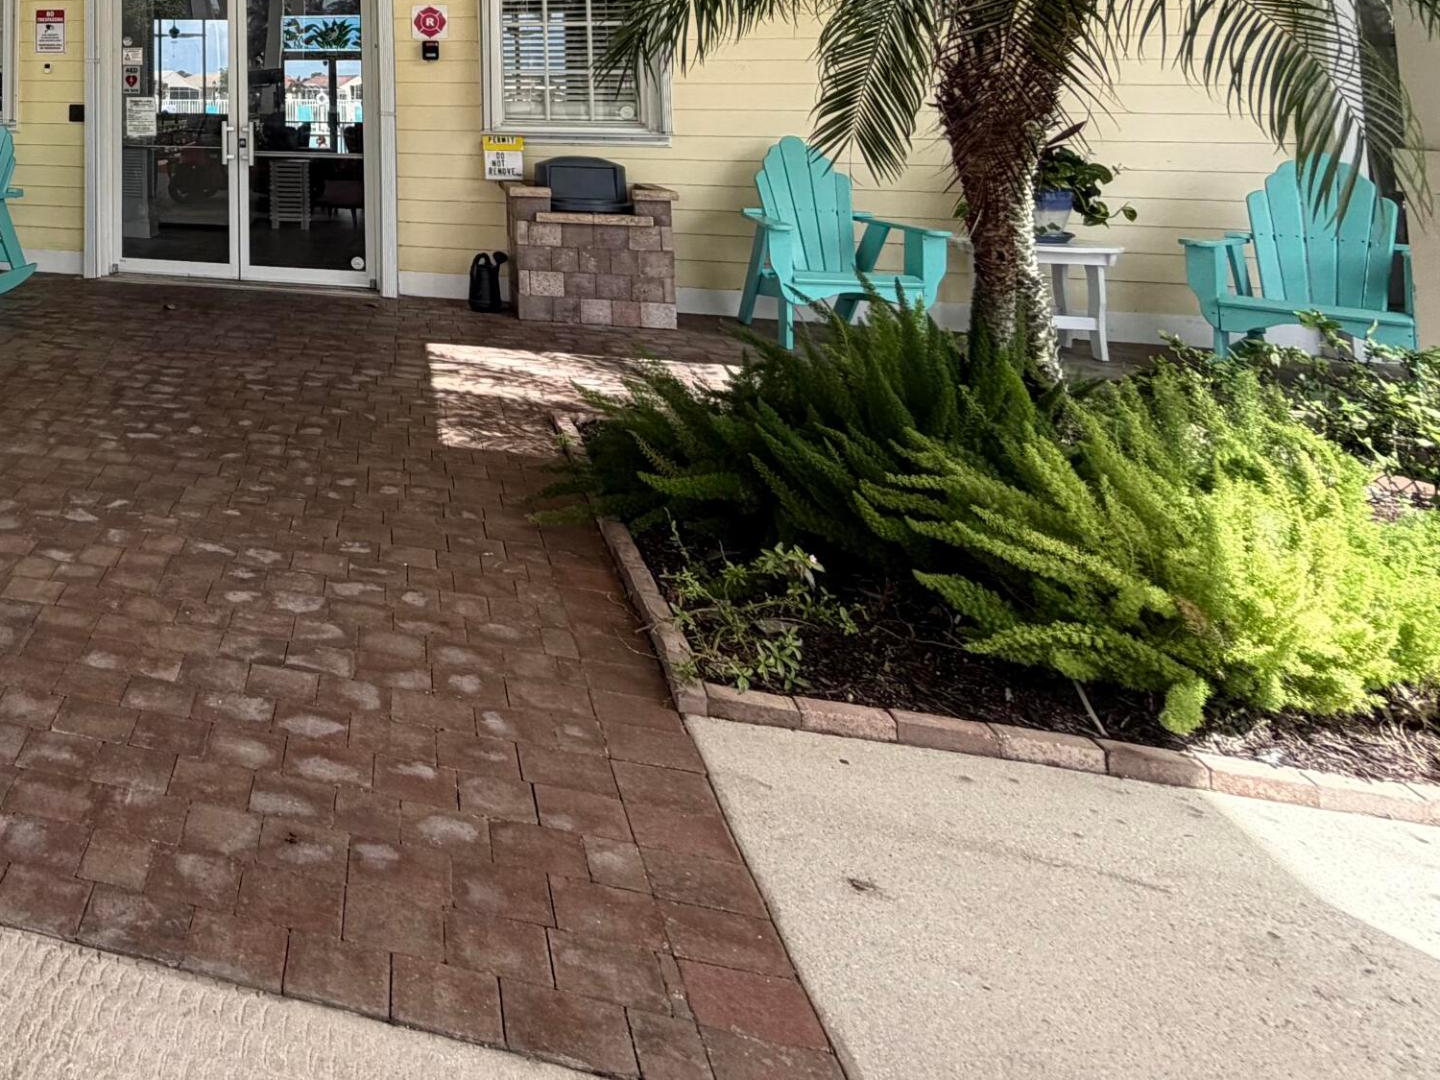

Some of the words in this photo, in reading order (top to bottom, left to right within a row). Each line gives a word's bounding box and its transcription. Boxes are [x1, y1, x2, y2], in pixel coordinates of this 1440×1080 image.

[426, 18, 435, 27] R
[496, 151, 505, 159] DO
[489, 167, 516, 176] REMOVE
